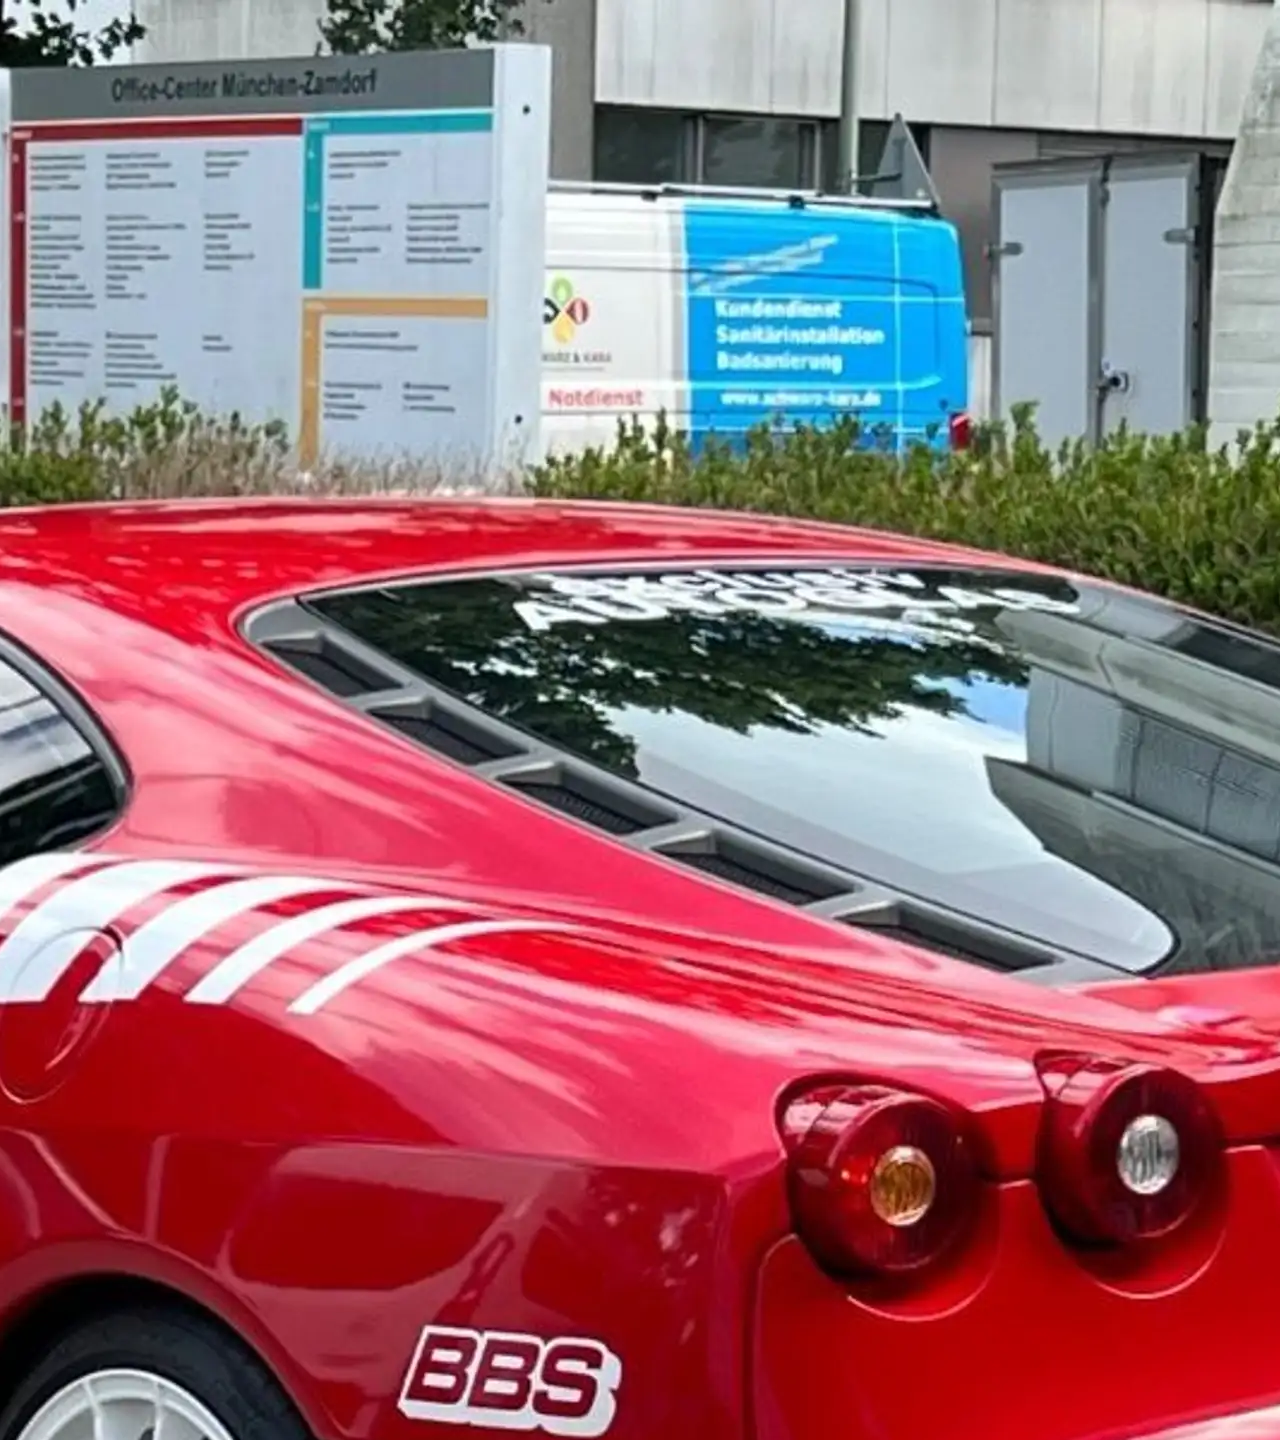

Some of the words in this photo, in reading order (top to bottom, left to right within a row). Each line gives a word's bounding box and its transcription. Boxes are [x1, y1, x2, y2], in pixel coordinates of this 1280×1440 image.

[112, 75, 218, 103] Office-Center
[222, 68, 378, 98] München-Zamdorf
[714, 299, 843, 319] Kundendienst
[716, 350, 843, 376] Badsanierung
[548, 387, 644, 408] Notdienst
[397, 1325, 622, 1438] BBS
